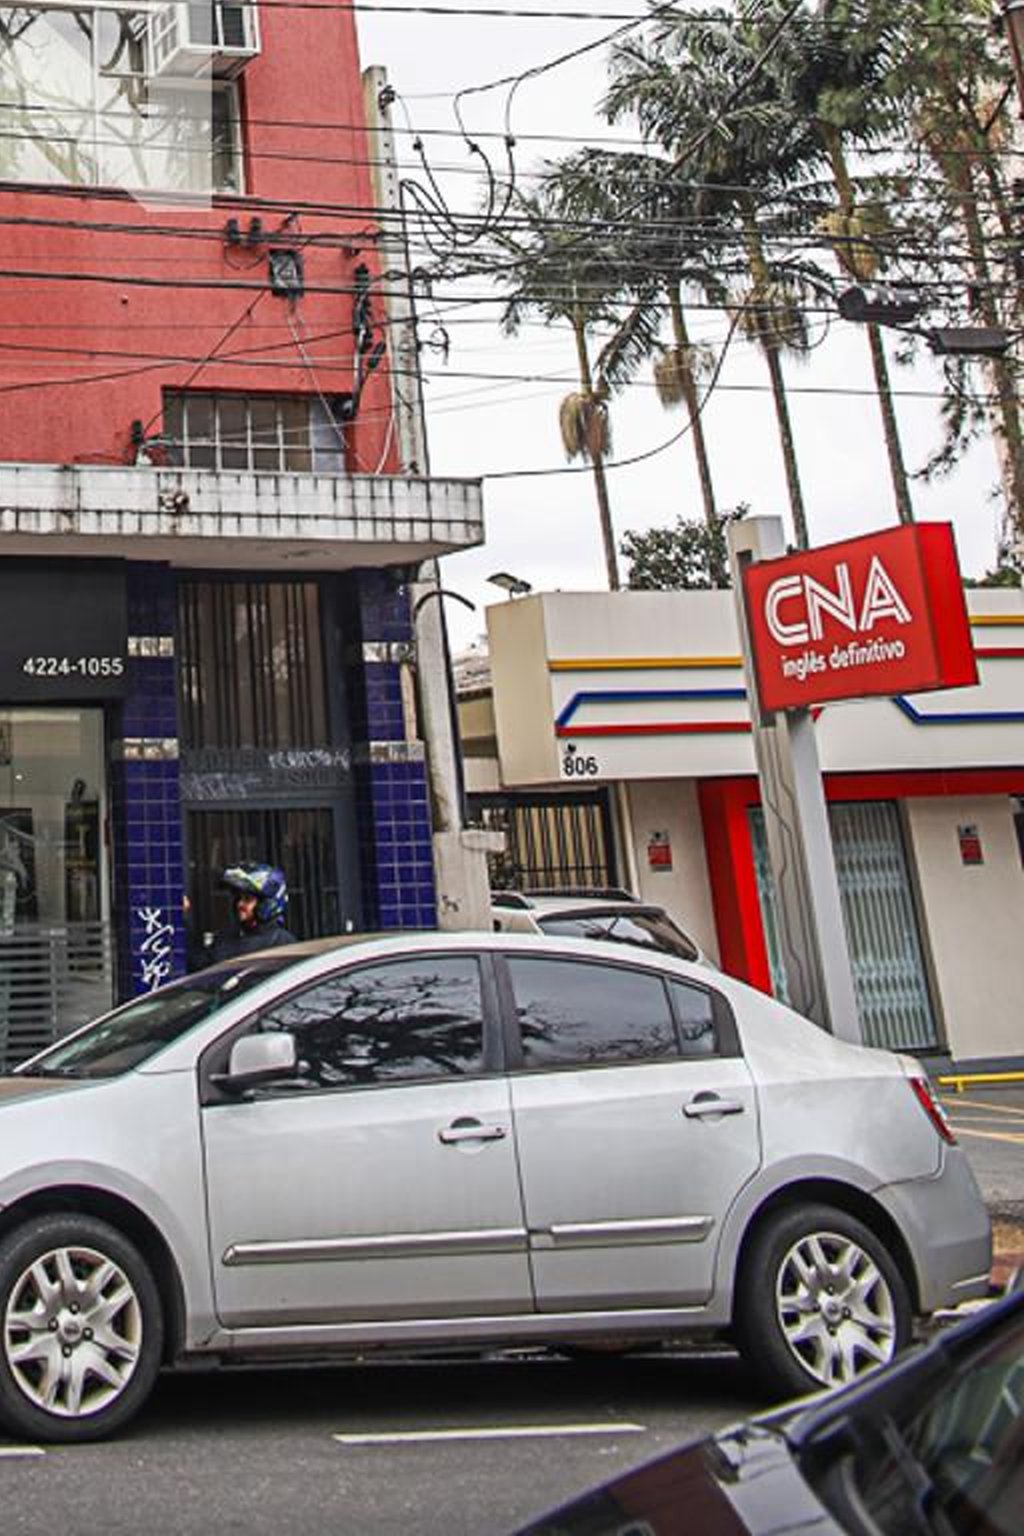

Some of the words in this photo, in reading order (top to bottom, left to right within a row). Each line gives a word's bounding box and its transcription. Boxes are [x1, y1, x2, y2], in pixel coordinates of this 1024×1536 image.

[764, 554, 912, 647] CNA
[23, 657, 125, 676] 4224-1055
[782, 651, 827, 681] inglês
[829, 636, 906, 670] definitivo
[563, 756, 599, 776] 806
